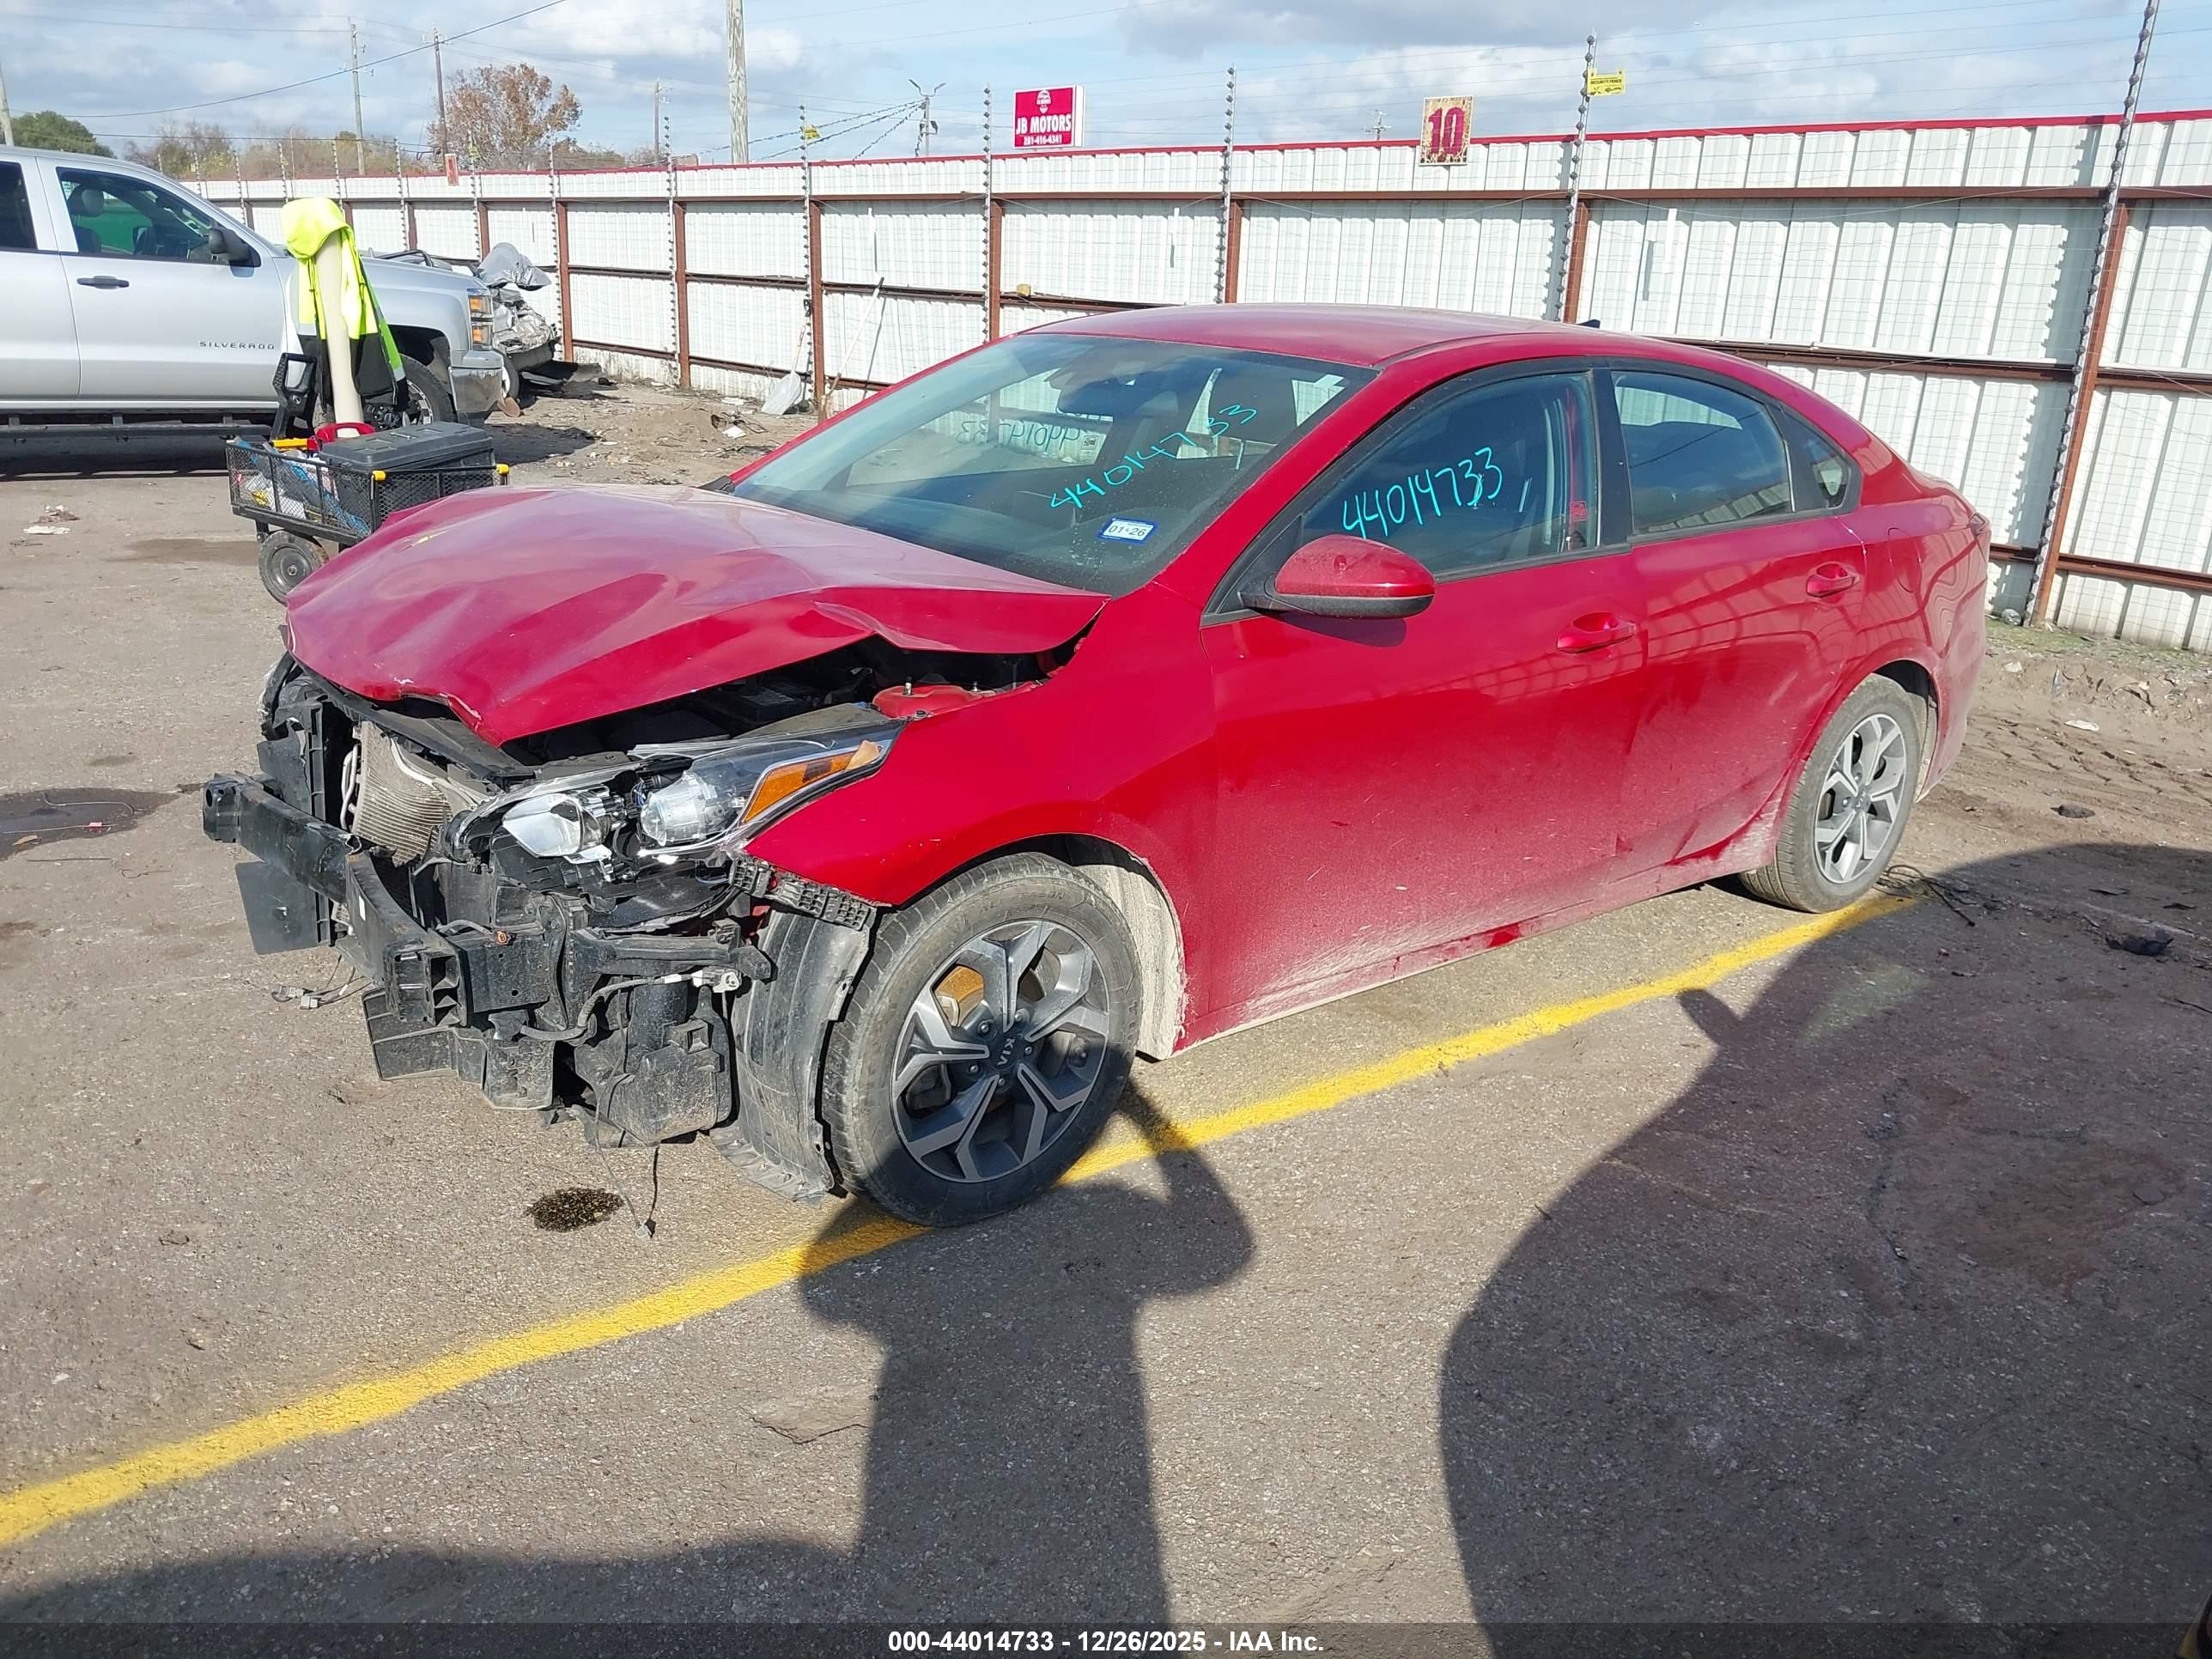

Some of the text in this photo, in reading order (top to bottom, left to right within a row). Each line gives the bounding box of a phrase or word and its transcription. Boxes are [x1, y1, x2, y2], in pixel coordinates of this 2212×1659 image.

[1016, 114, 1072, 134] JB MOTORS
[1428, 107, 1465, 155] 10
[199, 341, 275, 350] SILVERADO
[1050, 404, 1257, 508] 44014733
[1344, 447, 1502, 539] 44014733
[997, 1037, 1016, 1066] KIA
